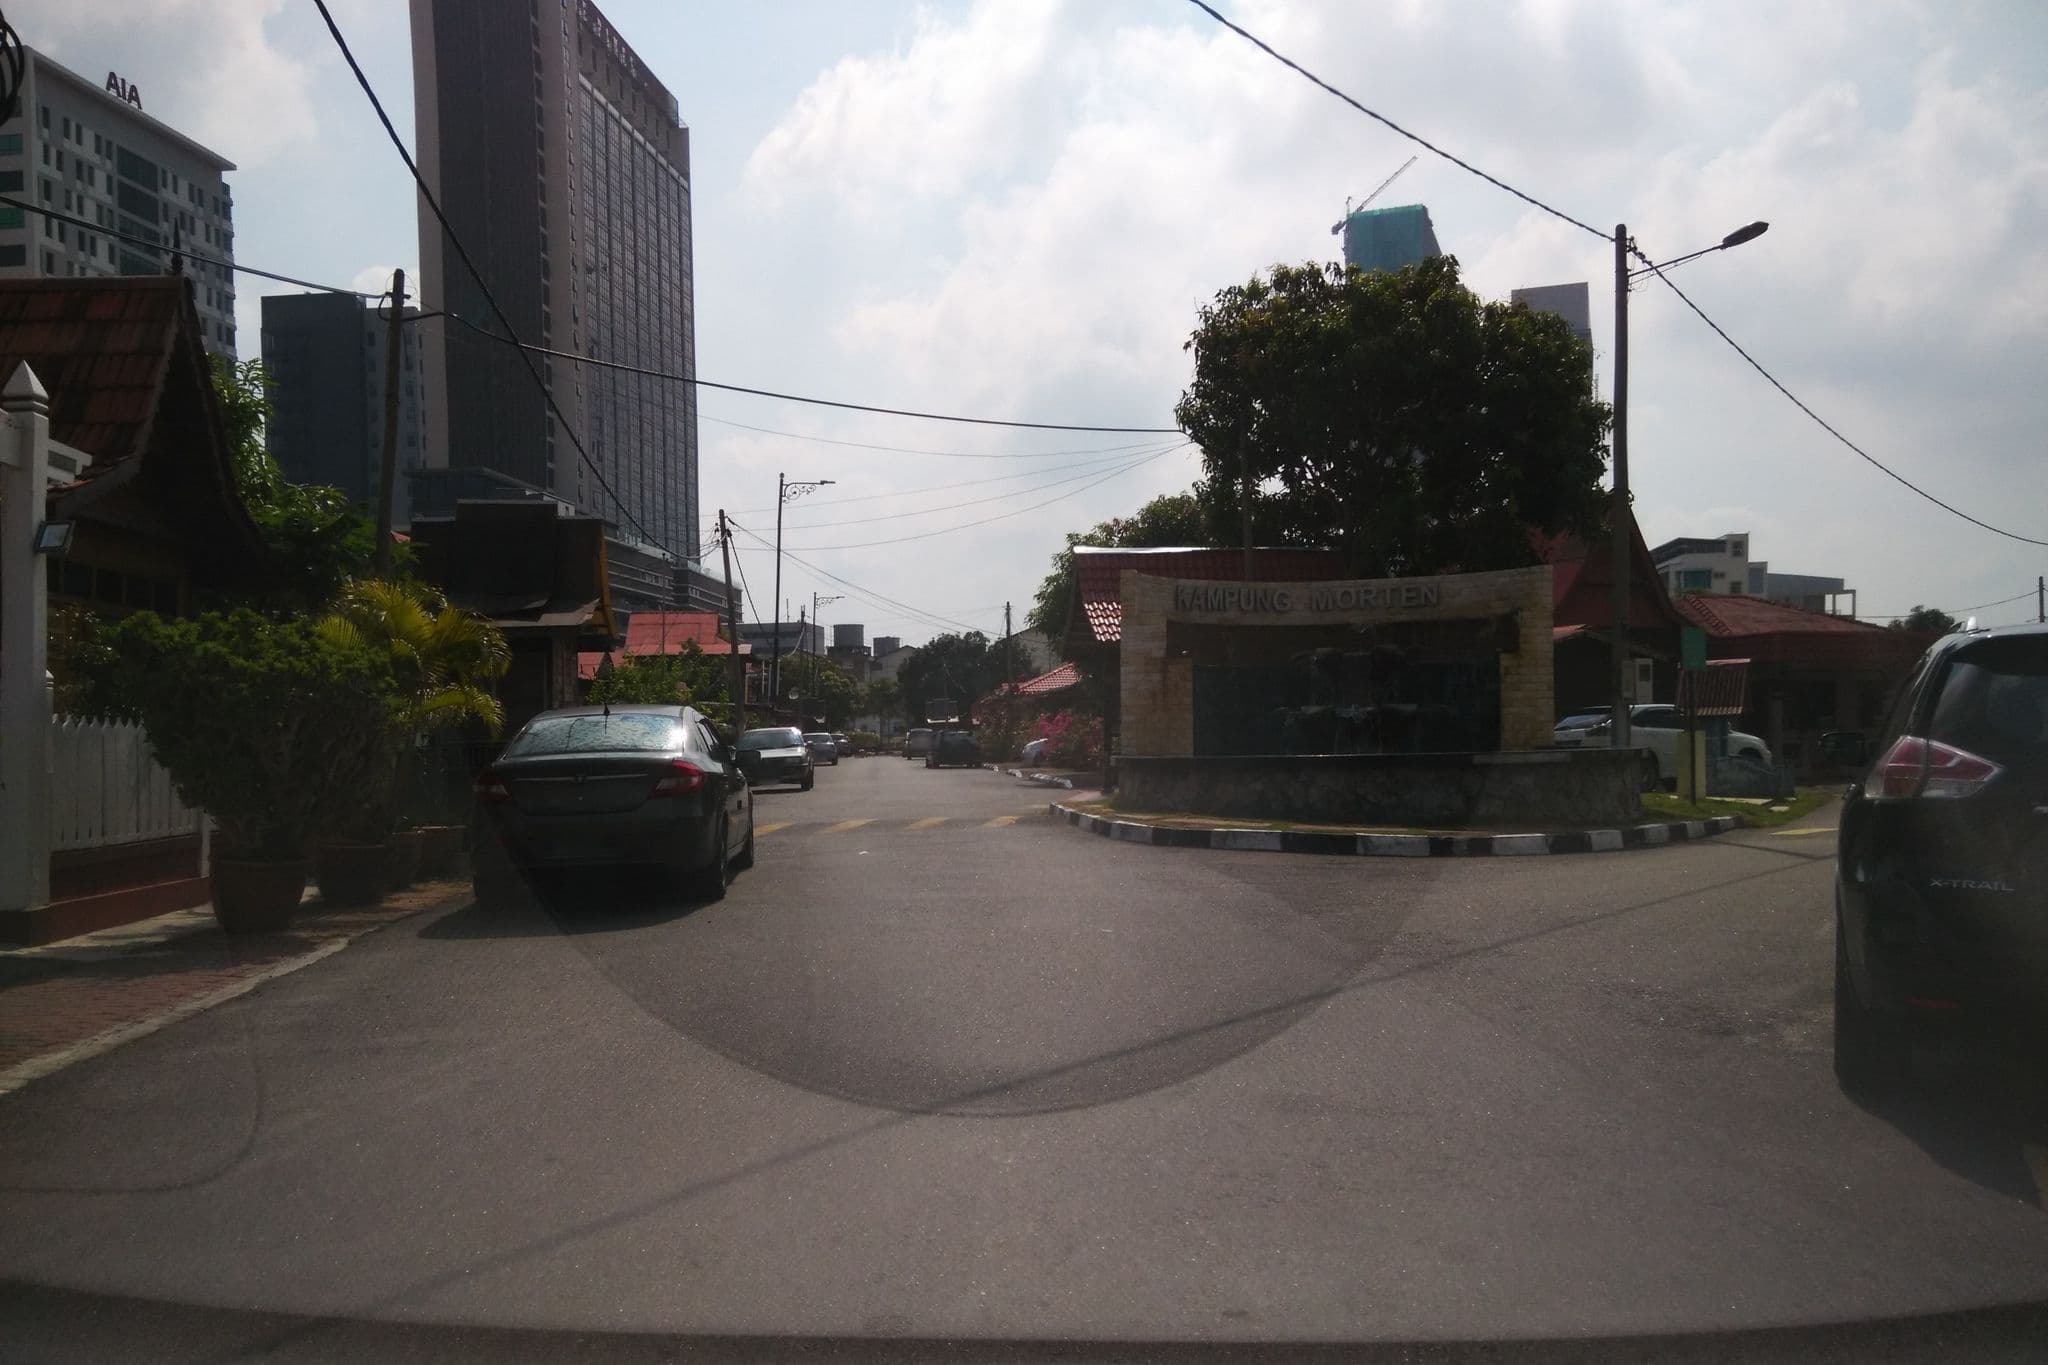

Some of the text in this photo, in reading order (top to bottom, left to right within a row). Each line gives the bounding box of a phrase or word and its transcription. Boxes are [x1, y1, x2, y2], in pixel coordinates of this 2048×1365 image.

[105, 71, 142, 110] AIA
[1175, 583, 1440, 612] KAMPUNG MORTEN
[1929, 879, 2016, 892] X-TRAIL
